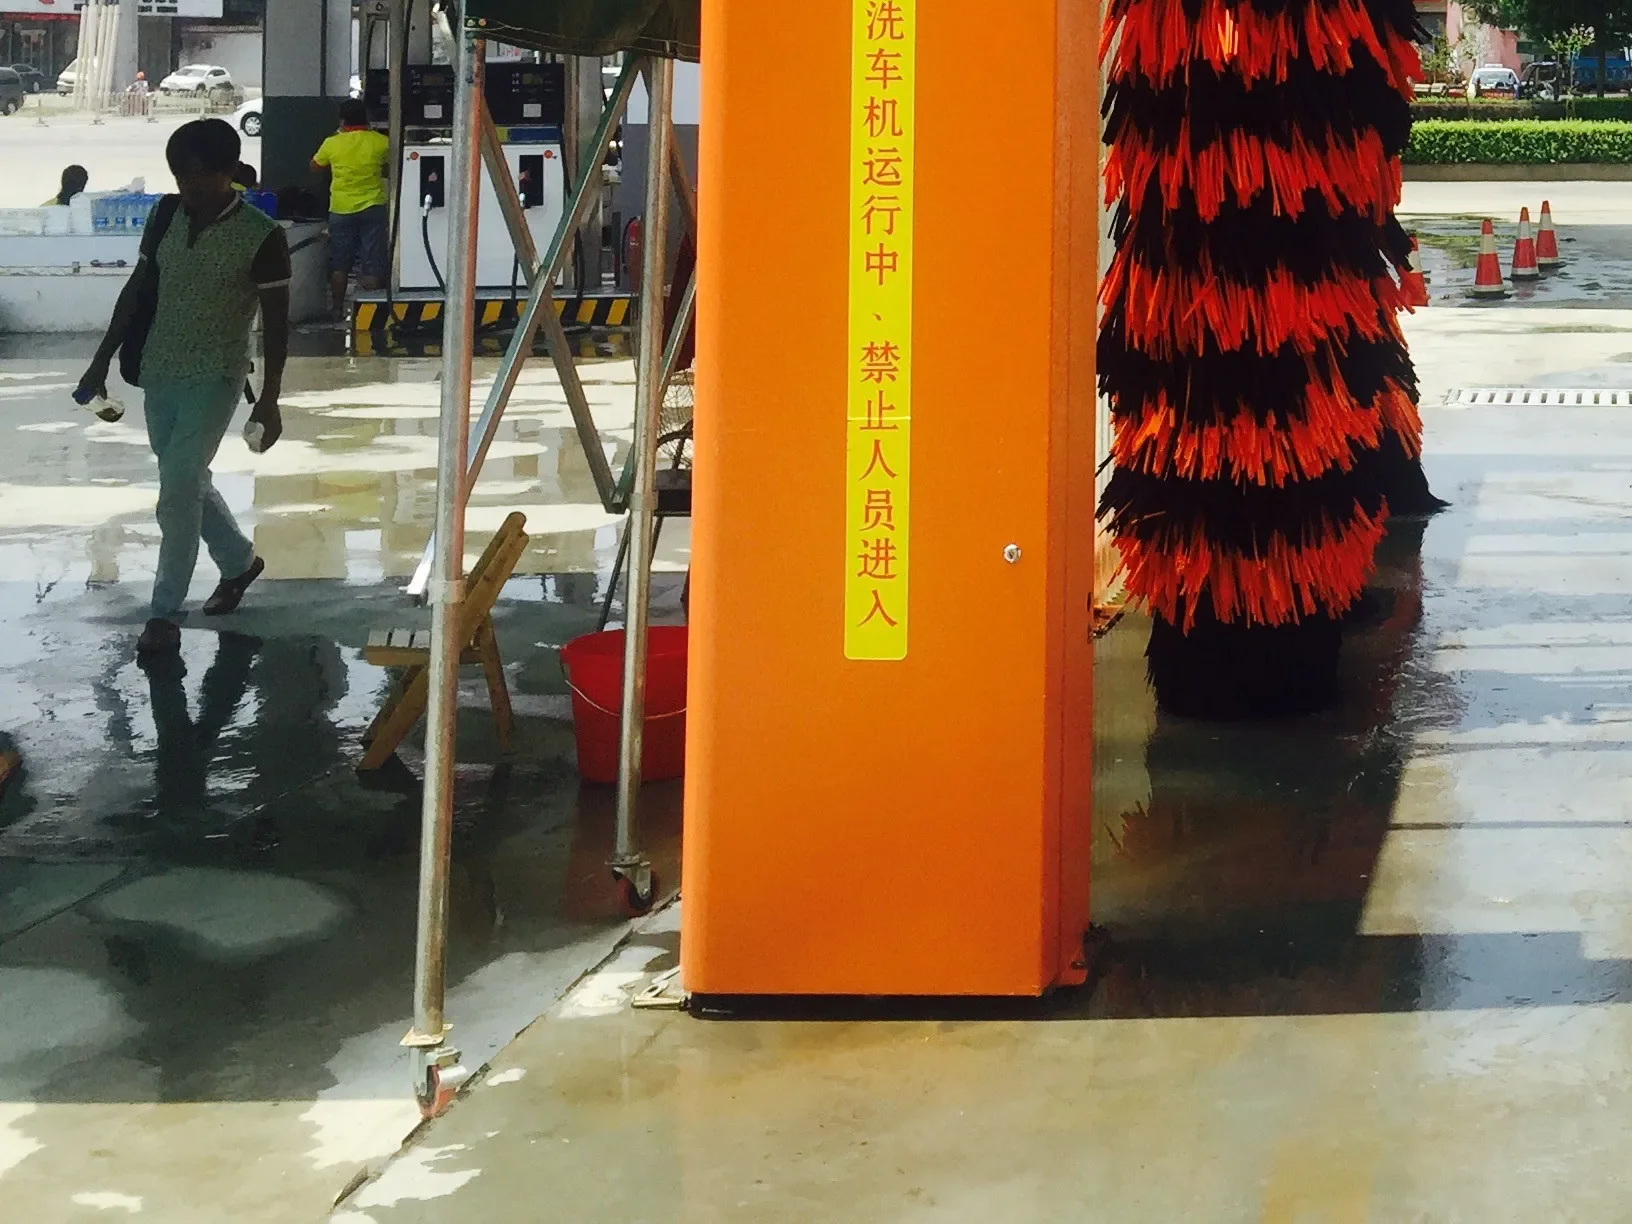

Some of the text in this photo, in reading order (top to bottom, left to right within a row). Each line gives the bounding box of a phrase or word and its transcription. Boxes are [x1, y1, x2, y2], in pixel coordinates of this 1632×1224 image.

[856, 0, 905, 628] 洗车机运行中、禁止人员进入
